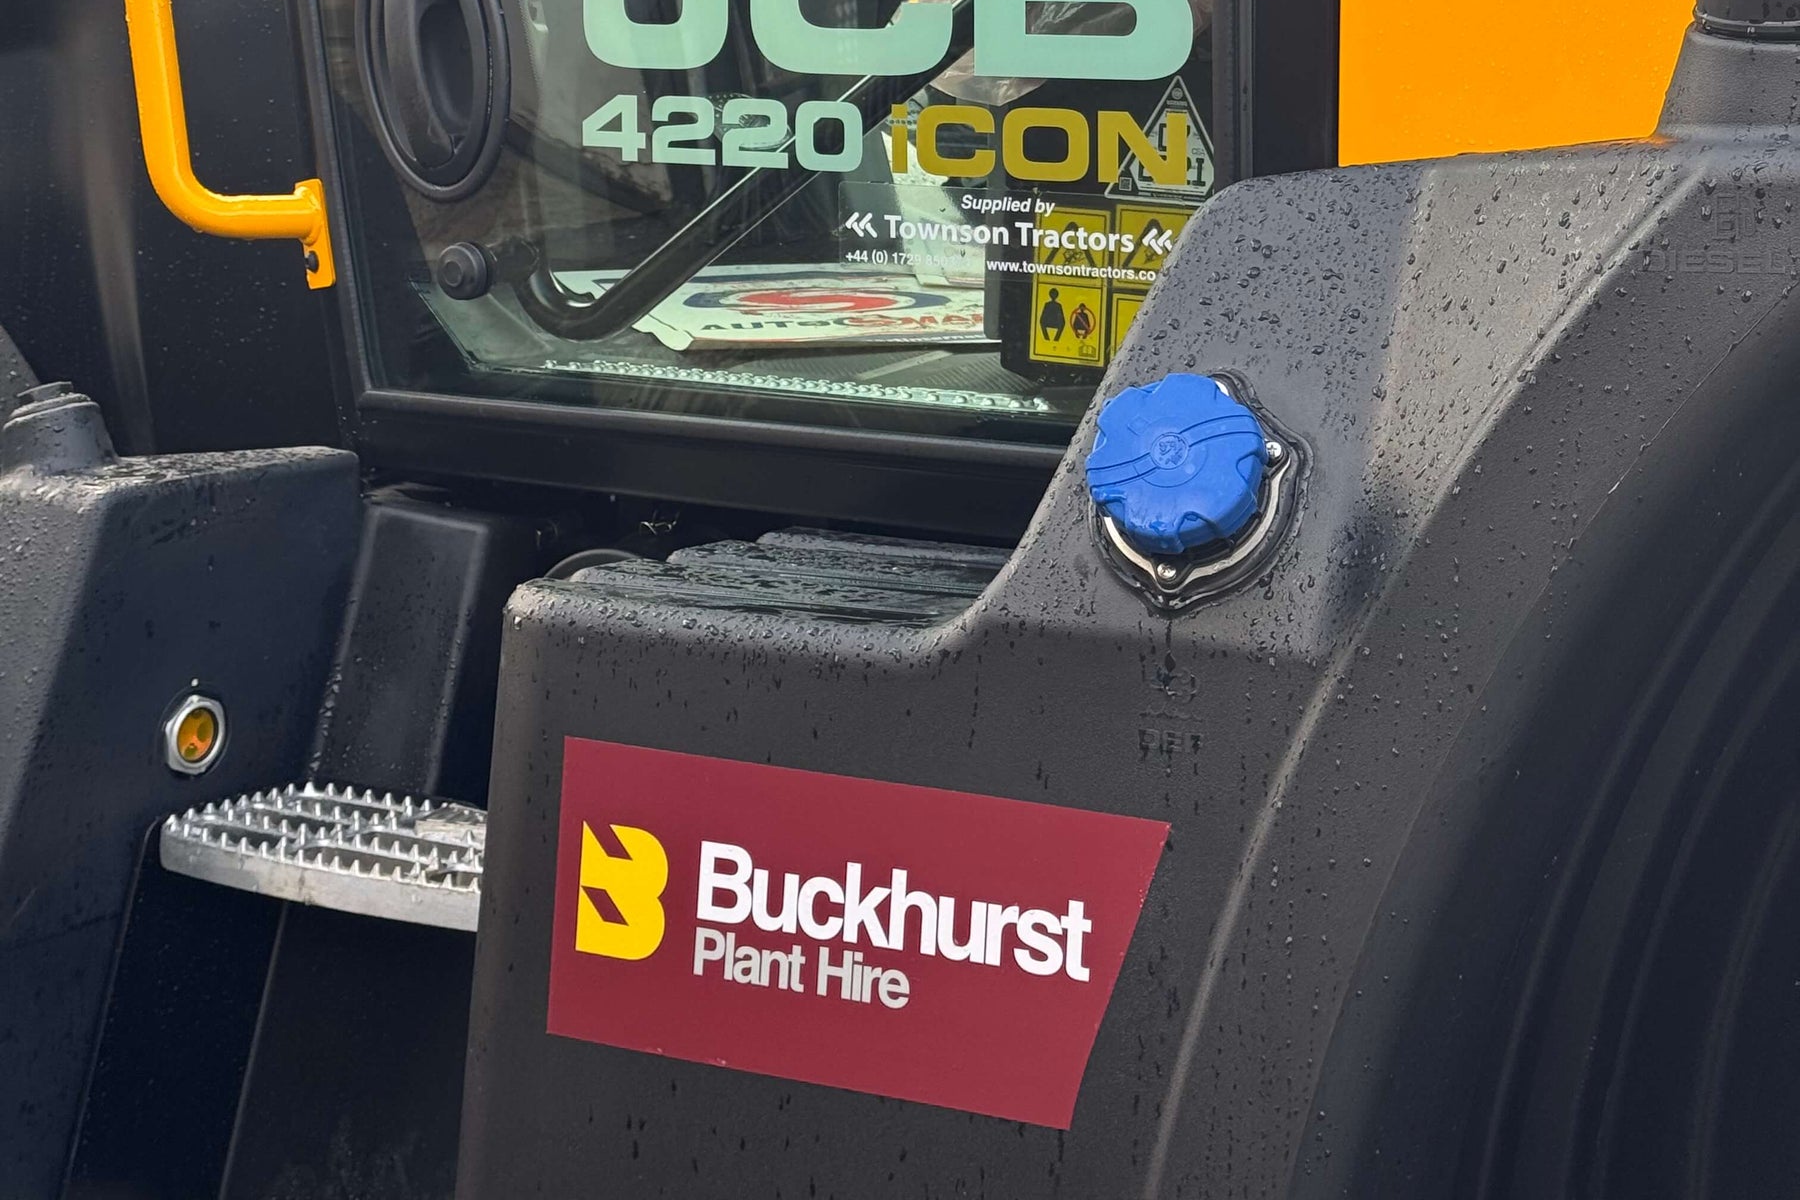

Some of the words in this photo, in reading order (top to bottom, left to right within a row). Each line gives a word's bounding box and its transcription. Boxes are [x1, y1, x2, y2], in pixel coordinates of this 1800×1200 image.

[582, 94, 863, 172] 4220
[961, 194, 1030, 216] Supplied
[1034, 198, 1055, 217] by
[884, 215, 1009, 246] Townson
[1014, 221, 1134, 253] Tractors
[845, 250, 868, 263] +44
[872, 249, 888, 265] (0)
[891, 252, 921, 266] 1729
[987, 259, 1156, 282] www.townsontractors.co
[1638, 250, 1786, 274] DIESEL
[696, 840, 1093, 982] Buckhurst
[692, 926, 805, 994] Plant
[816, 946, 911, 1009] Hire
